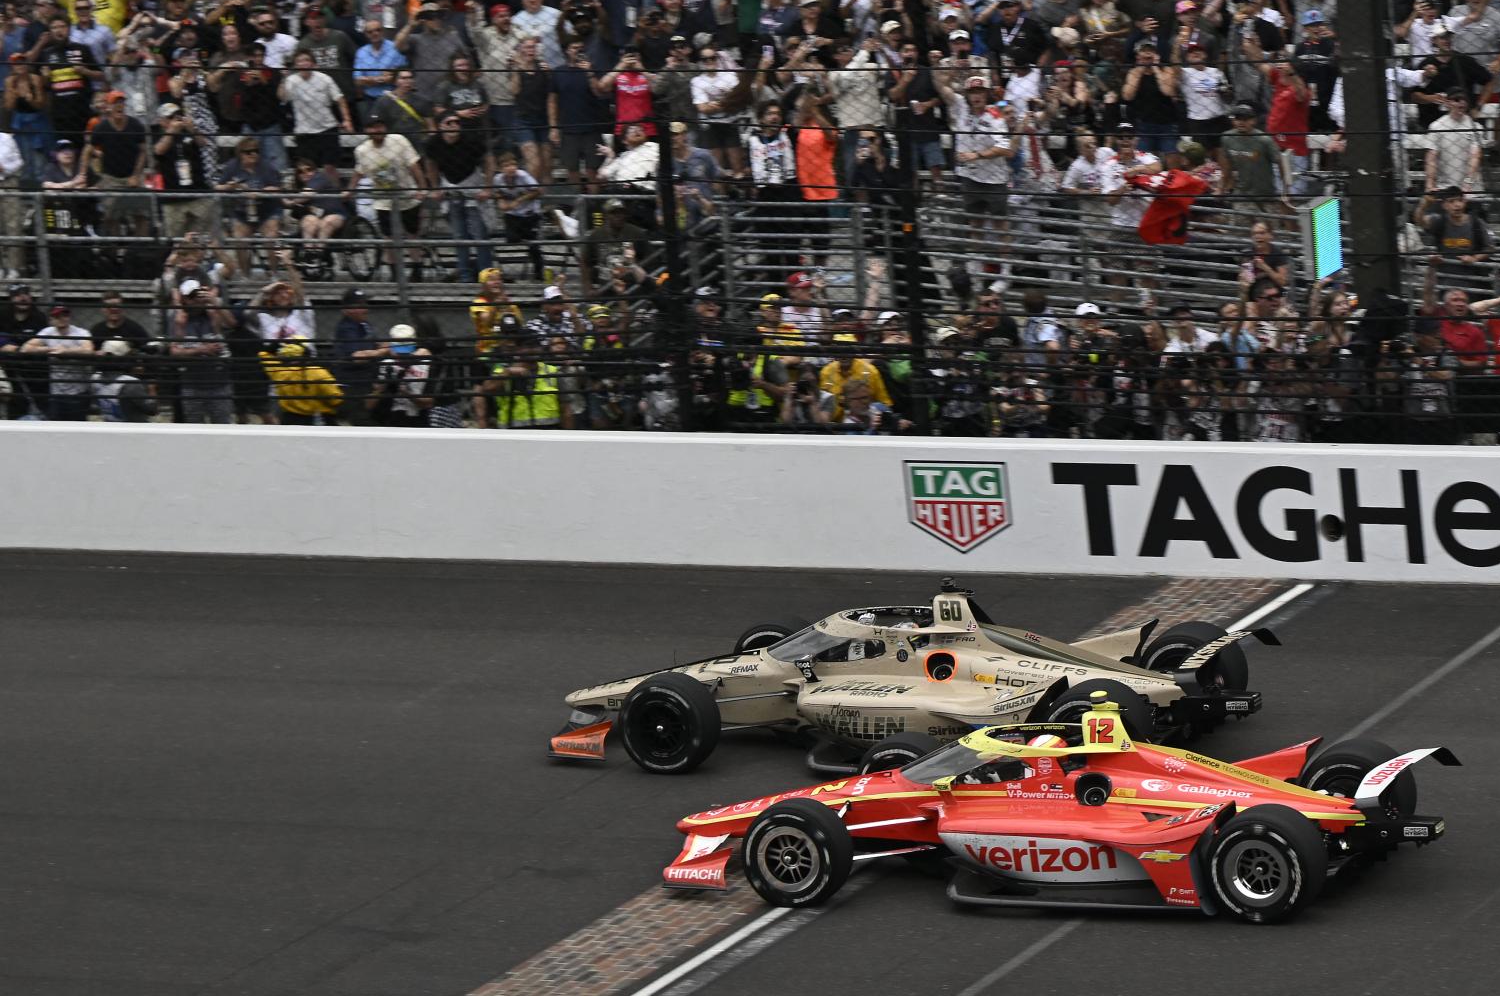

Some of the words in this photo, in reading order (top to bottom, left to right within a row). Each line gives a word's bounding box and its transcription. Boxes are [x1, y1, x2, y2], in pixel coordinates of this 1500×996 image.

[913, 469, 999, 495] TAG
[916, 503, 1004, 543] HEUER
[1051, 462, 1320, 563] TAG
[939, 600, 962, 621] 60
[997, 668, 1045, 679] Powered
[1017, 660, 1088, 676] CLIFFS
[993, 696, 1036, 713] SiriusXM
[816, 712, 905, 740] WALLEN
[1087, 718, 1114, 743] 12
[1185, 753, 1220, 769] Clarience
[1222, 764, 1270, 785] TECHNOLOGIES
[1007, 790, 1045, 799] V-Power
[1177, 784, 1253, 798] Gallagher
[964, 840, 1117, 872] verizon
[668, 868, 722, 880] HITACHI
